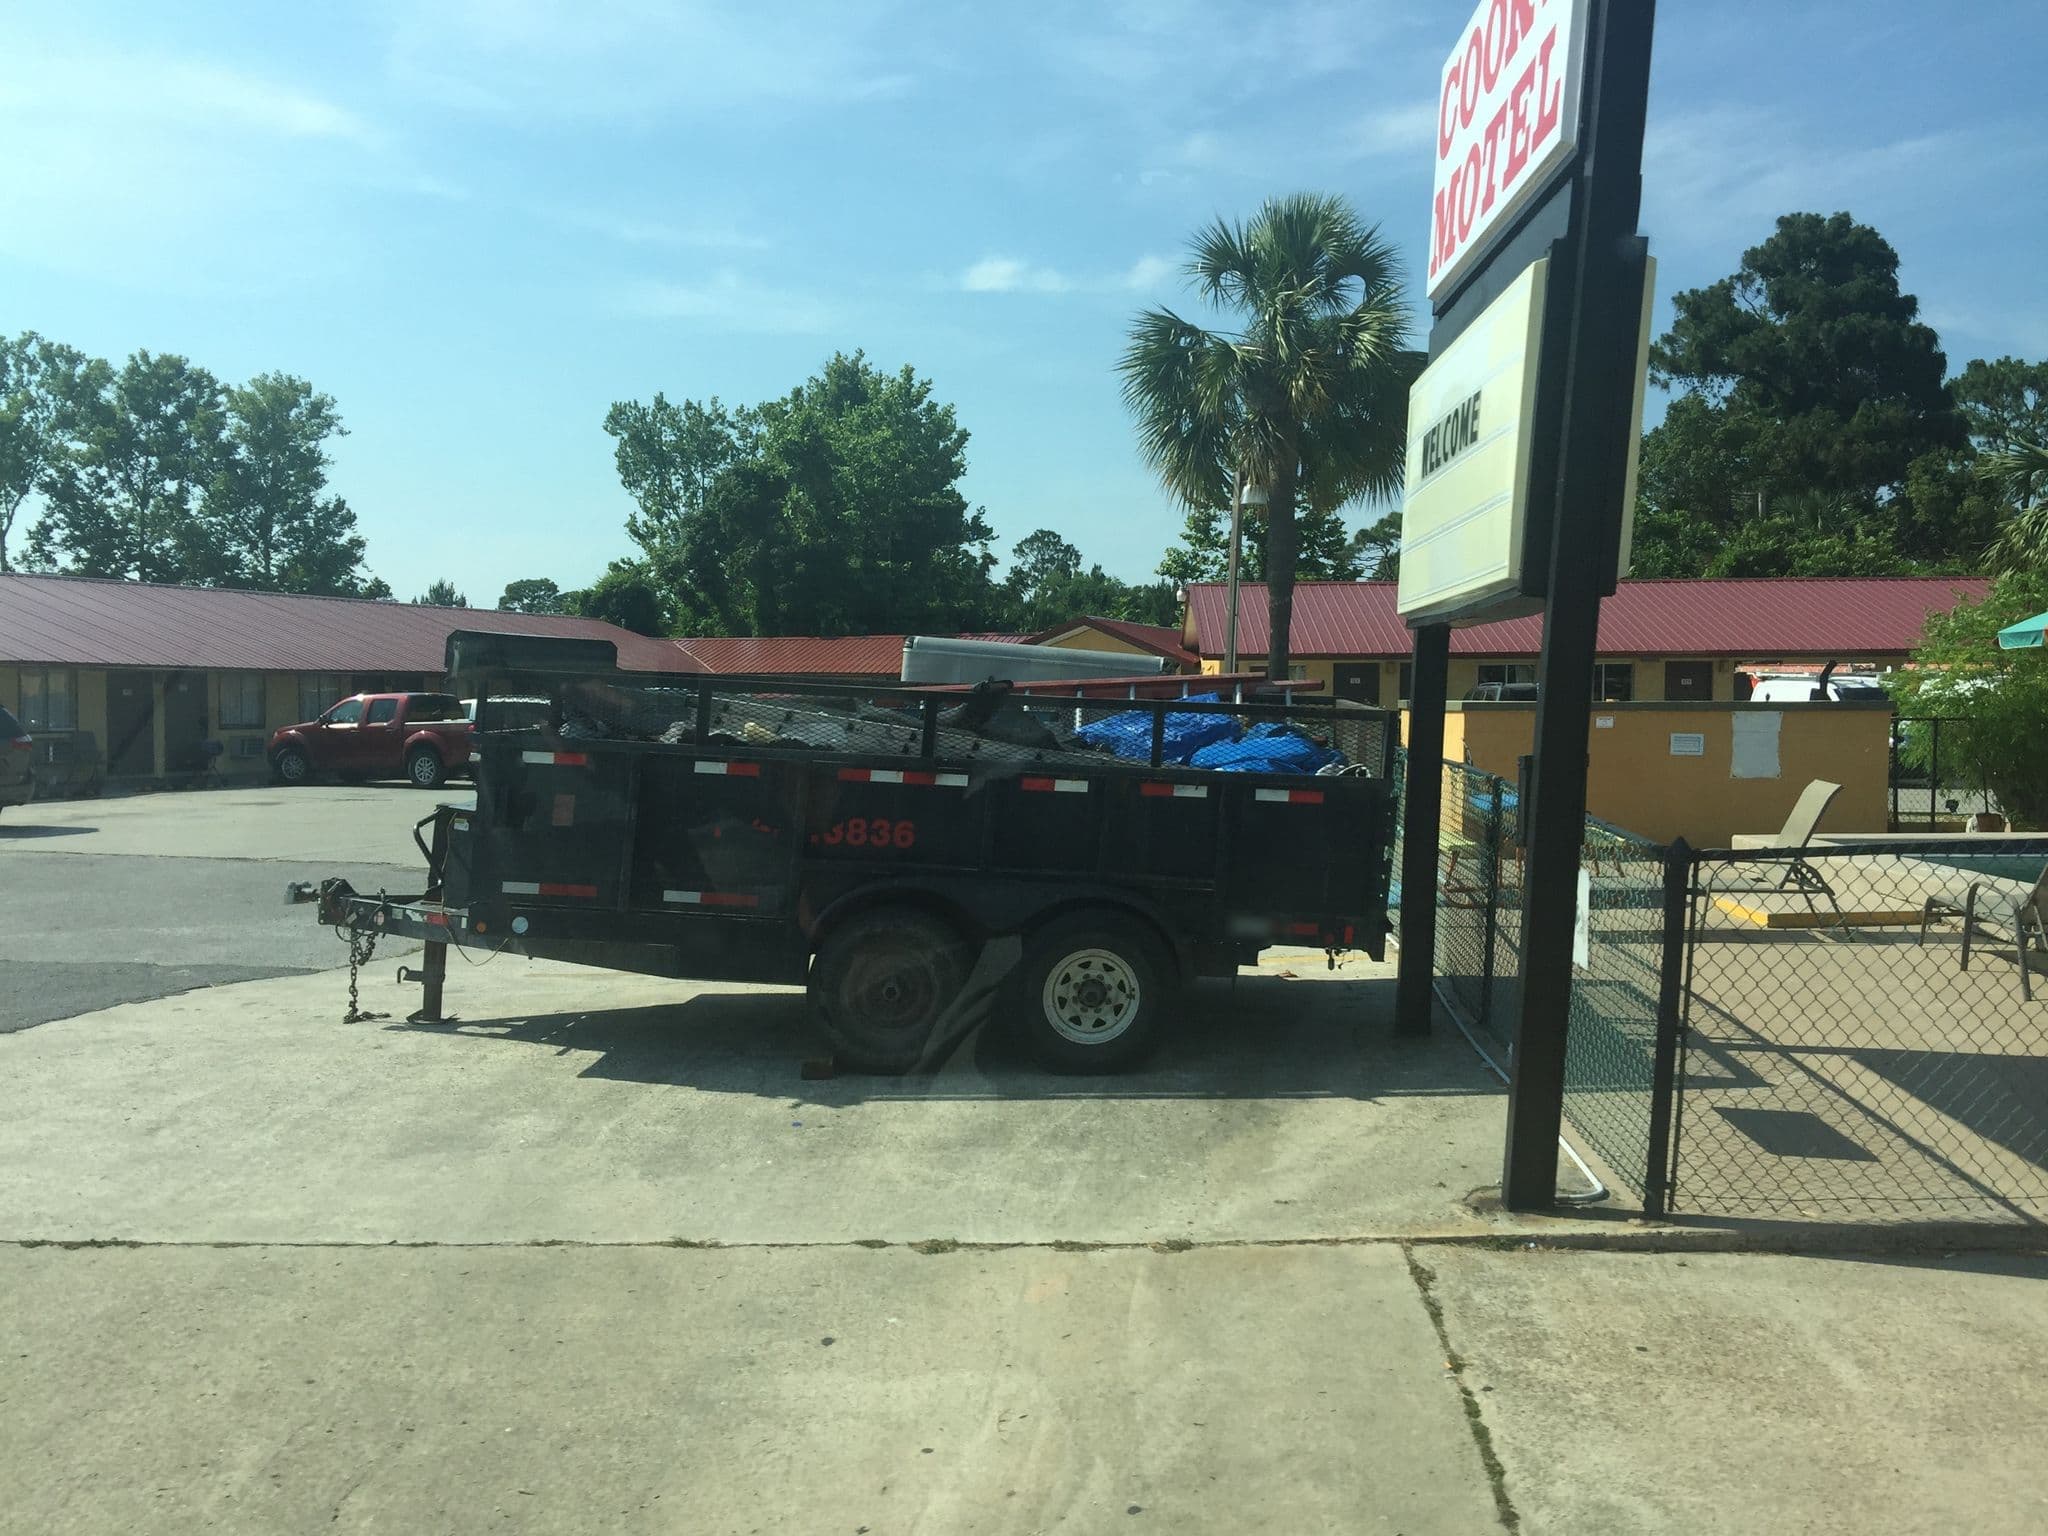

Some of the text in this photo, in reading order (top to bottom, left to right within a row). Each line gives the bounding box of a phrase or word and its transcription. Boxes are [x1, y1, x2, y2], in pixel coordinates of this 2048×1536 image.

[1430, 23, 1561, 280] MOTEL
[1439, 0, 1551, 160] COO
[1422, 389, 1482, 479] WELCOME
